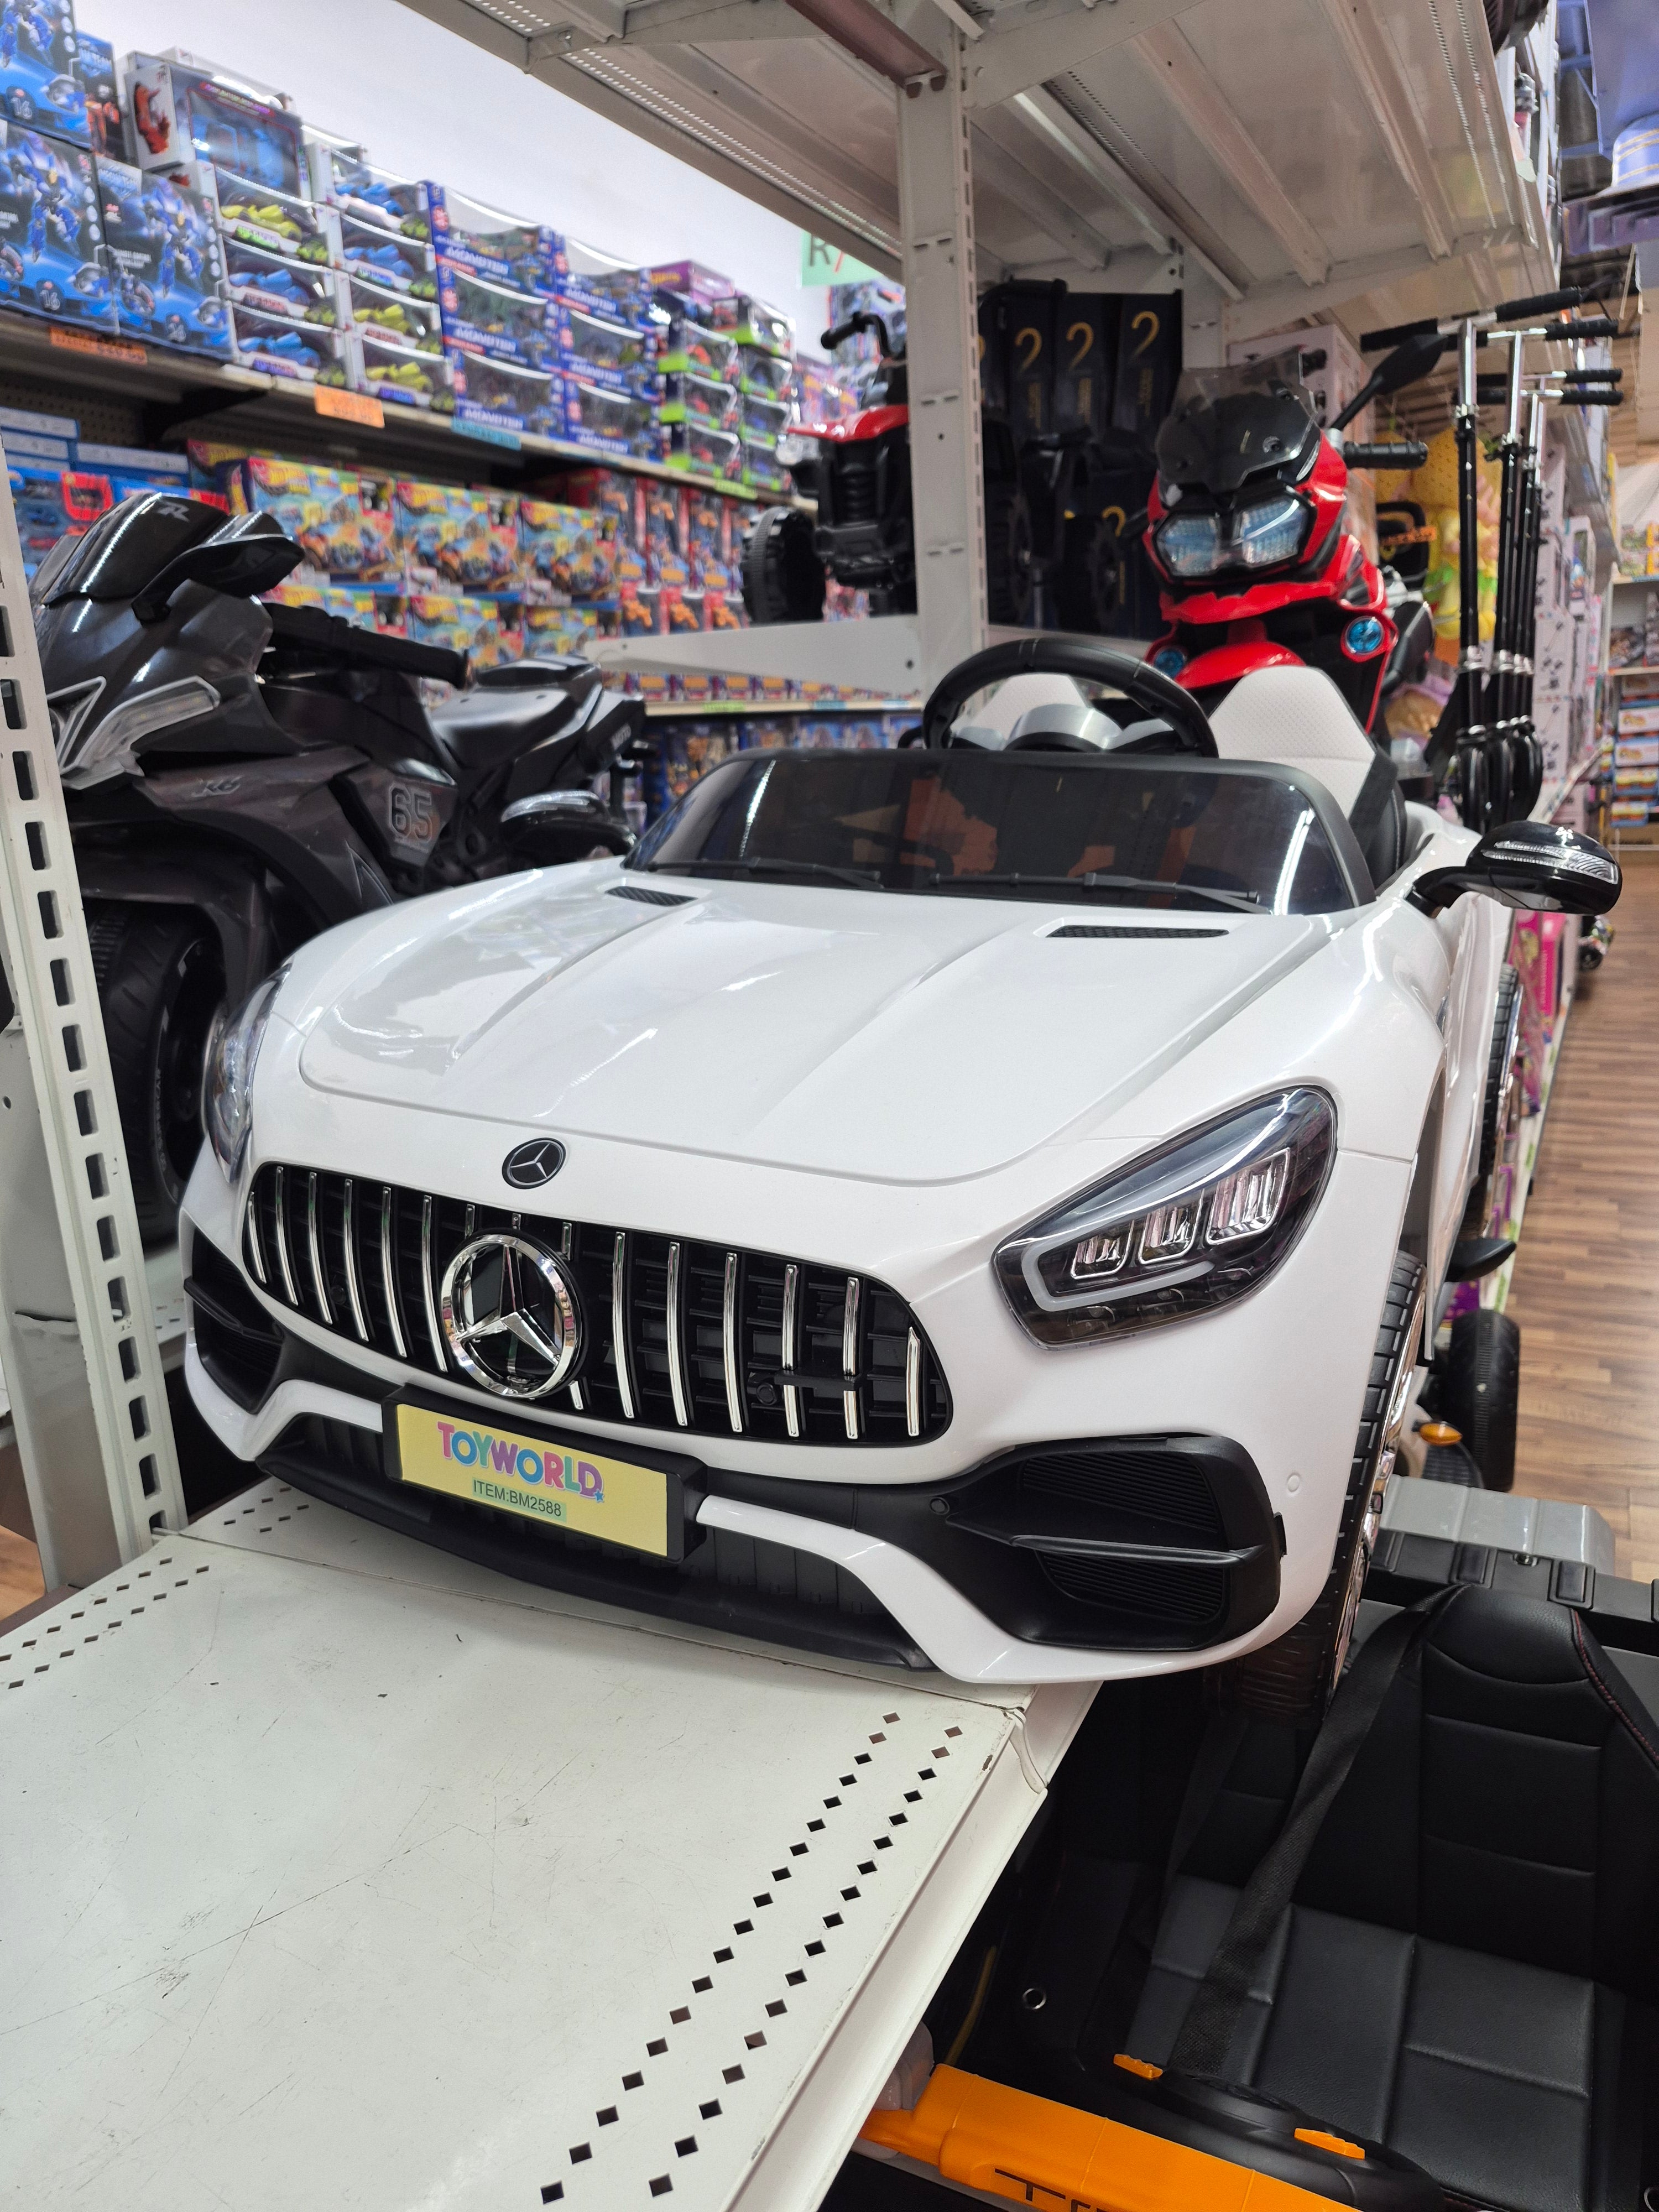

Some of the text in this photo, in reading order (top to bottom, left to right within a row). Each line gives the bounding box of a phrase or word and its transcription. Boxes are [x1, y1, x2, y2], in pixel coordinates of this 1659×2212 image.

[389, 782, 432, 841] 65
[437, 1421, 603, 1500] TOYWORLD
[473, 1479, 562, 1517] ITEM:BM2588
